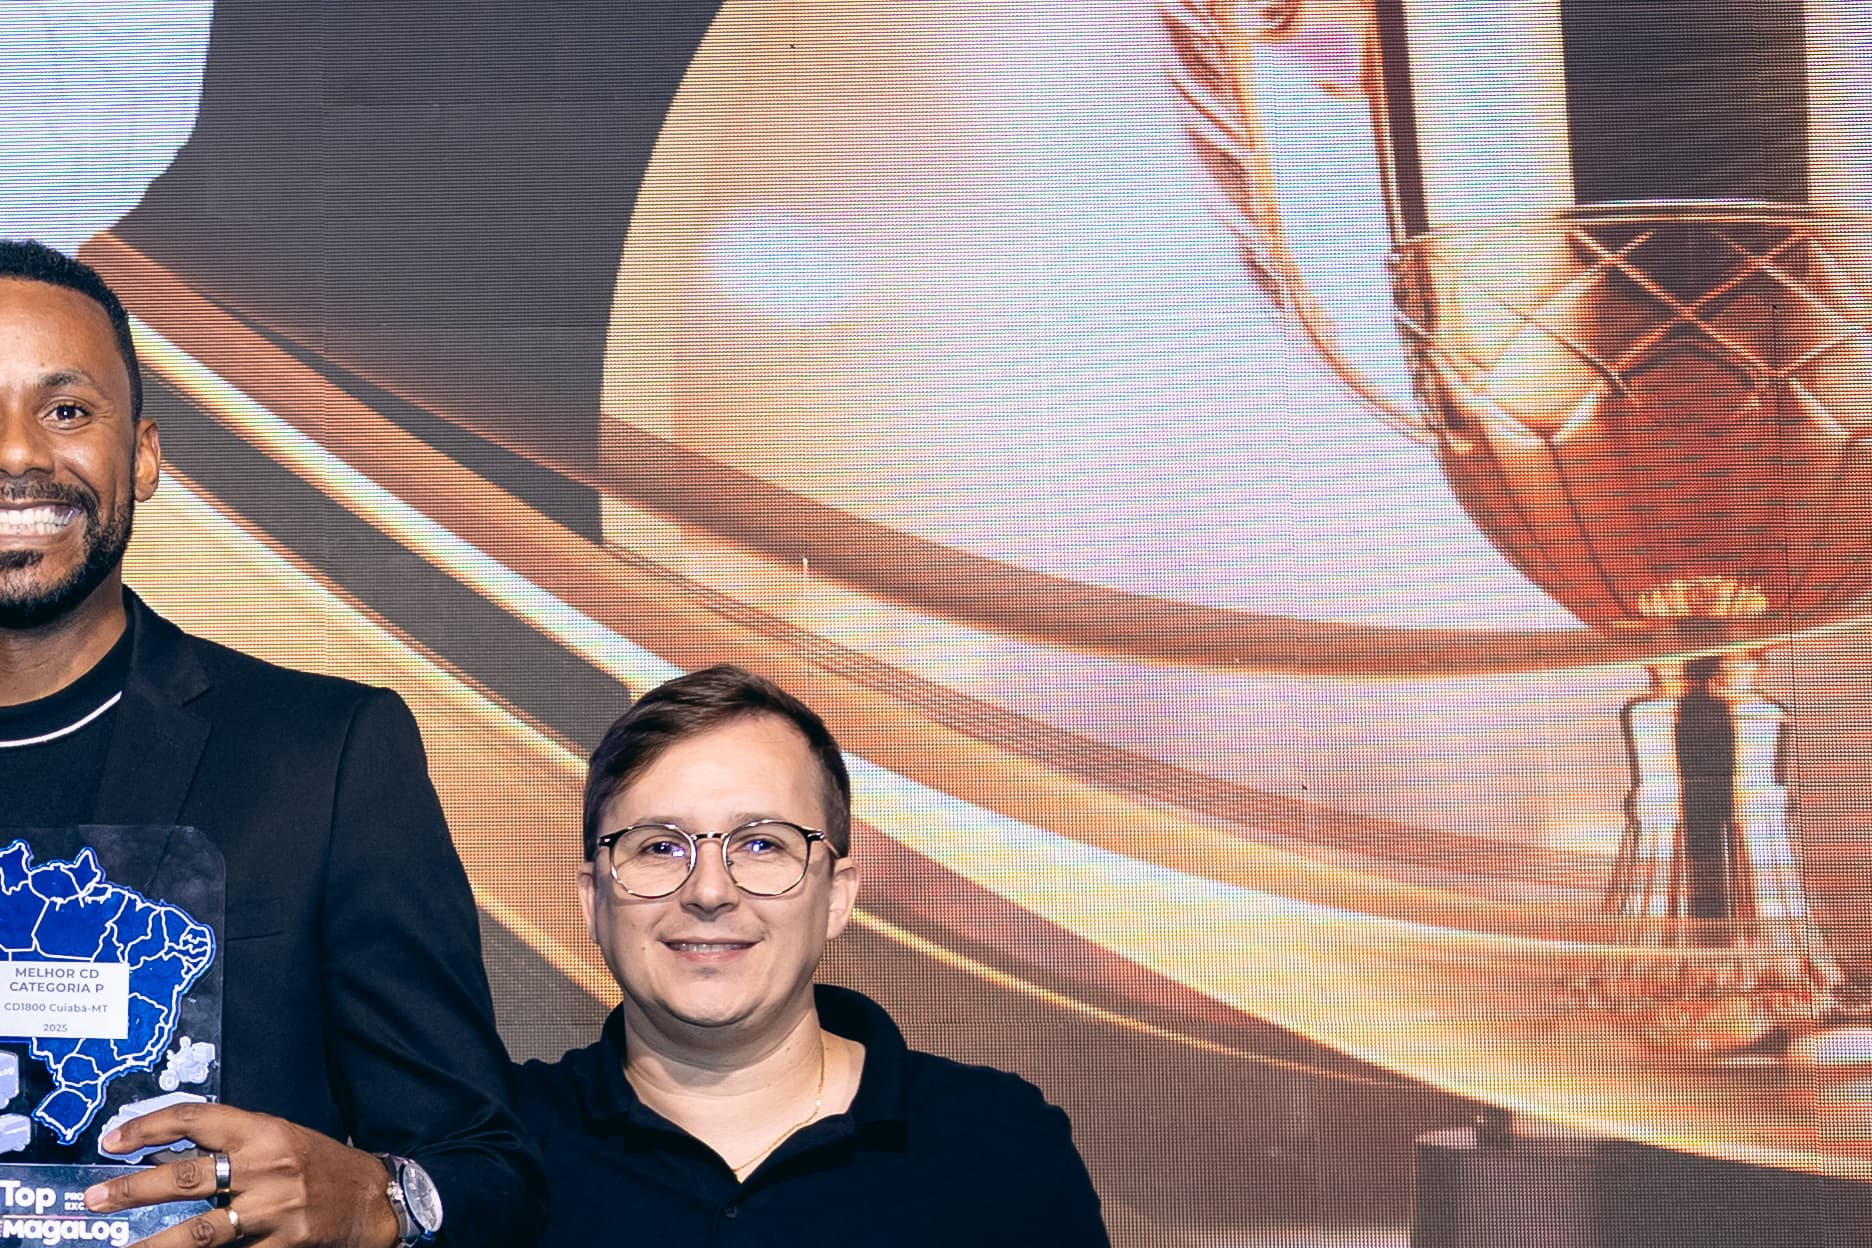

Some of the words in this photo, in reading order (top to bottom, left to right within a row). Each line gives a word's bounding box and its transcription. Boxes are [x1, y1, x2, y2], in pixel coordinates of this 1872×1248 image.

[15, 967, 75, 979] MELHOR
[79, 968, 100, 979] CD
[9, 981, 91, 993] CATEGORIA
[95, 983, 105, 993] P
[4, 1002, 46, 1012] CD1800
[43, 1023, 68, 1033] 2025
[64, 1201, 88, 1211] EXC
